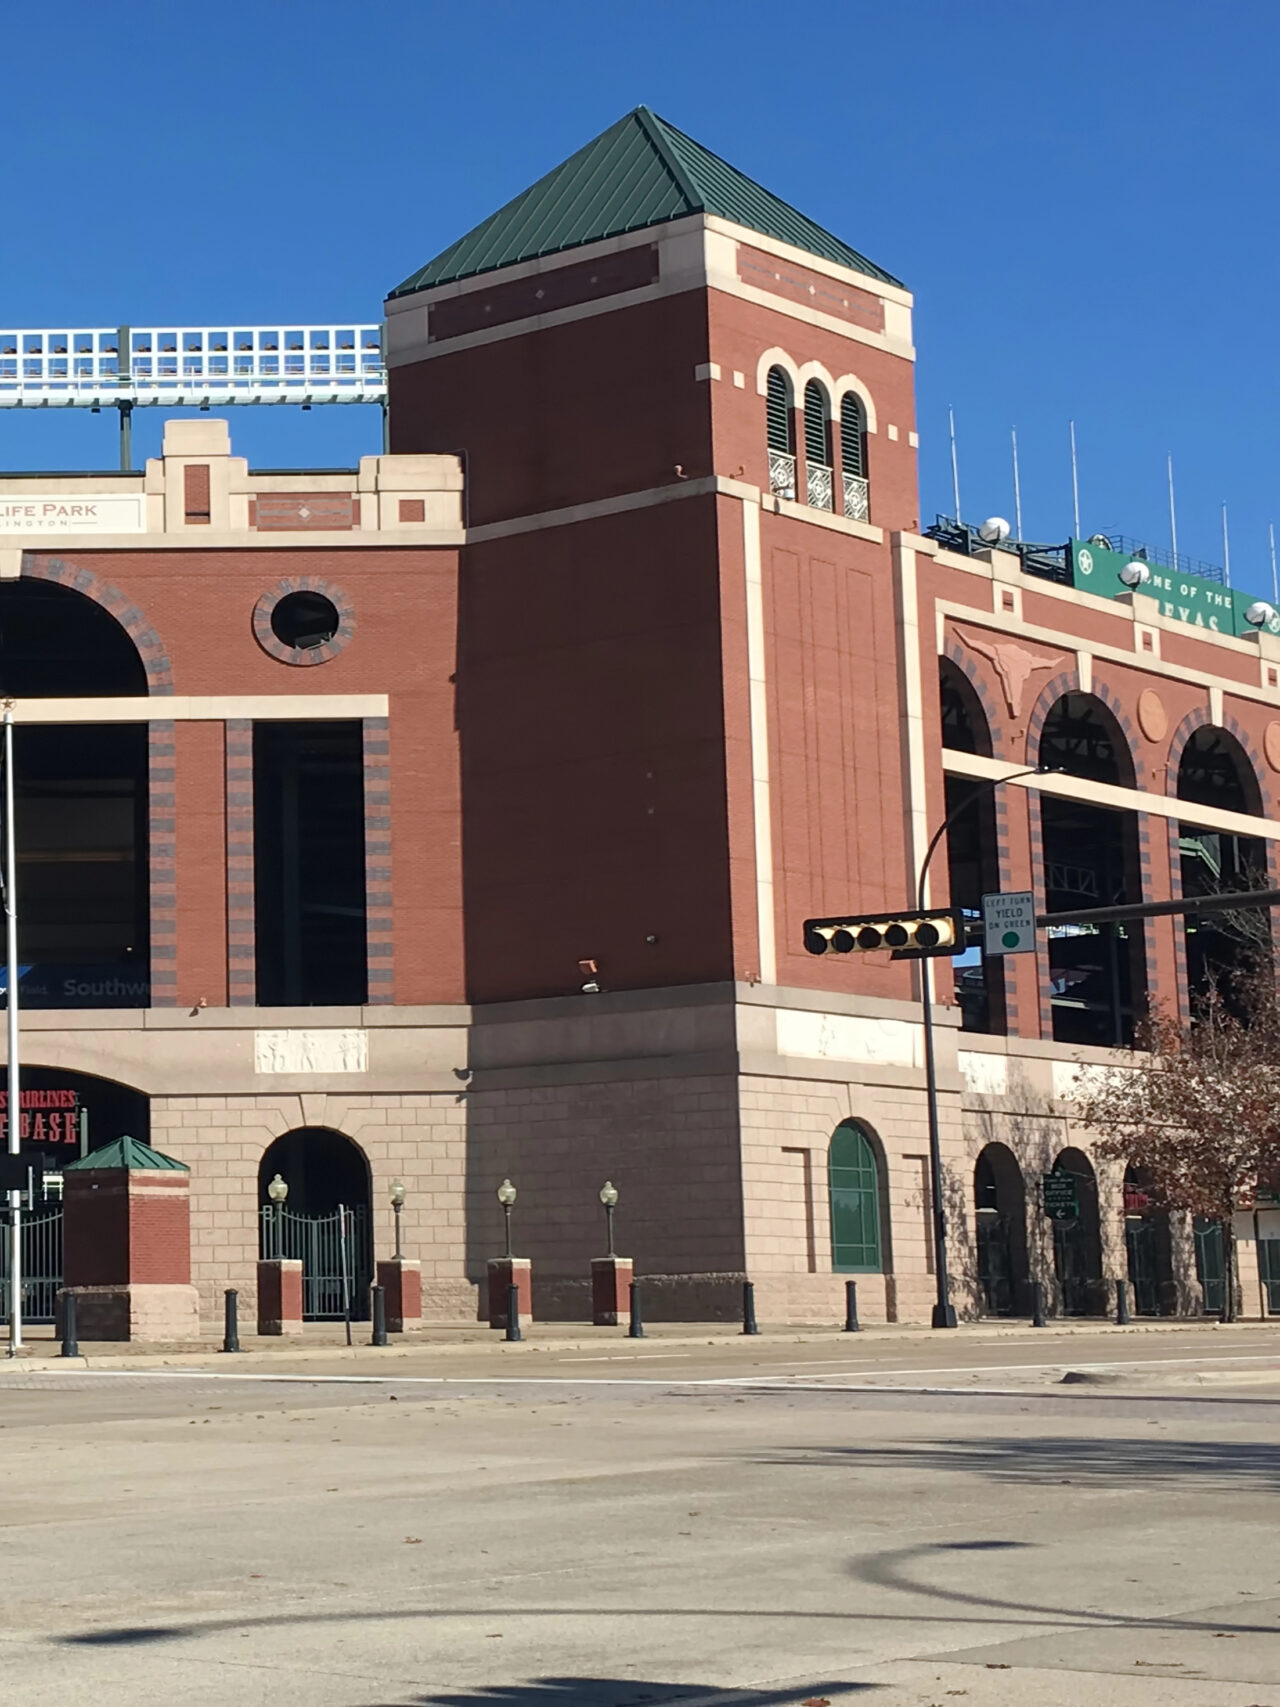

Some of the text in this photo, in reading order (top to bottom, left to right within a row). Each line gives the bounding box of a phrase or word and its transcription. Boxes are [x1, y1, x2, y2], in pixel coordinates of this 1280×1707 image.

[42, 503, 98, 517] PARK
[1180, 584, 1198, 598] OF
[1205, 591, 1232, 609] THE
[1163, 601, 1219, 632] EXAS
[986, 896, 1031, 907] LEFT TURN
[995, 908, 1023, 919] YIELD
[988, 919, 1031, 930] ON GREEN
[63, 979, 150, 997] Southw
[18, 1112, 76, 1144] BASE
